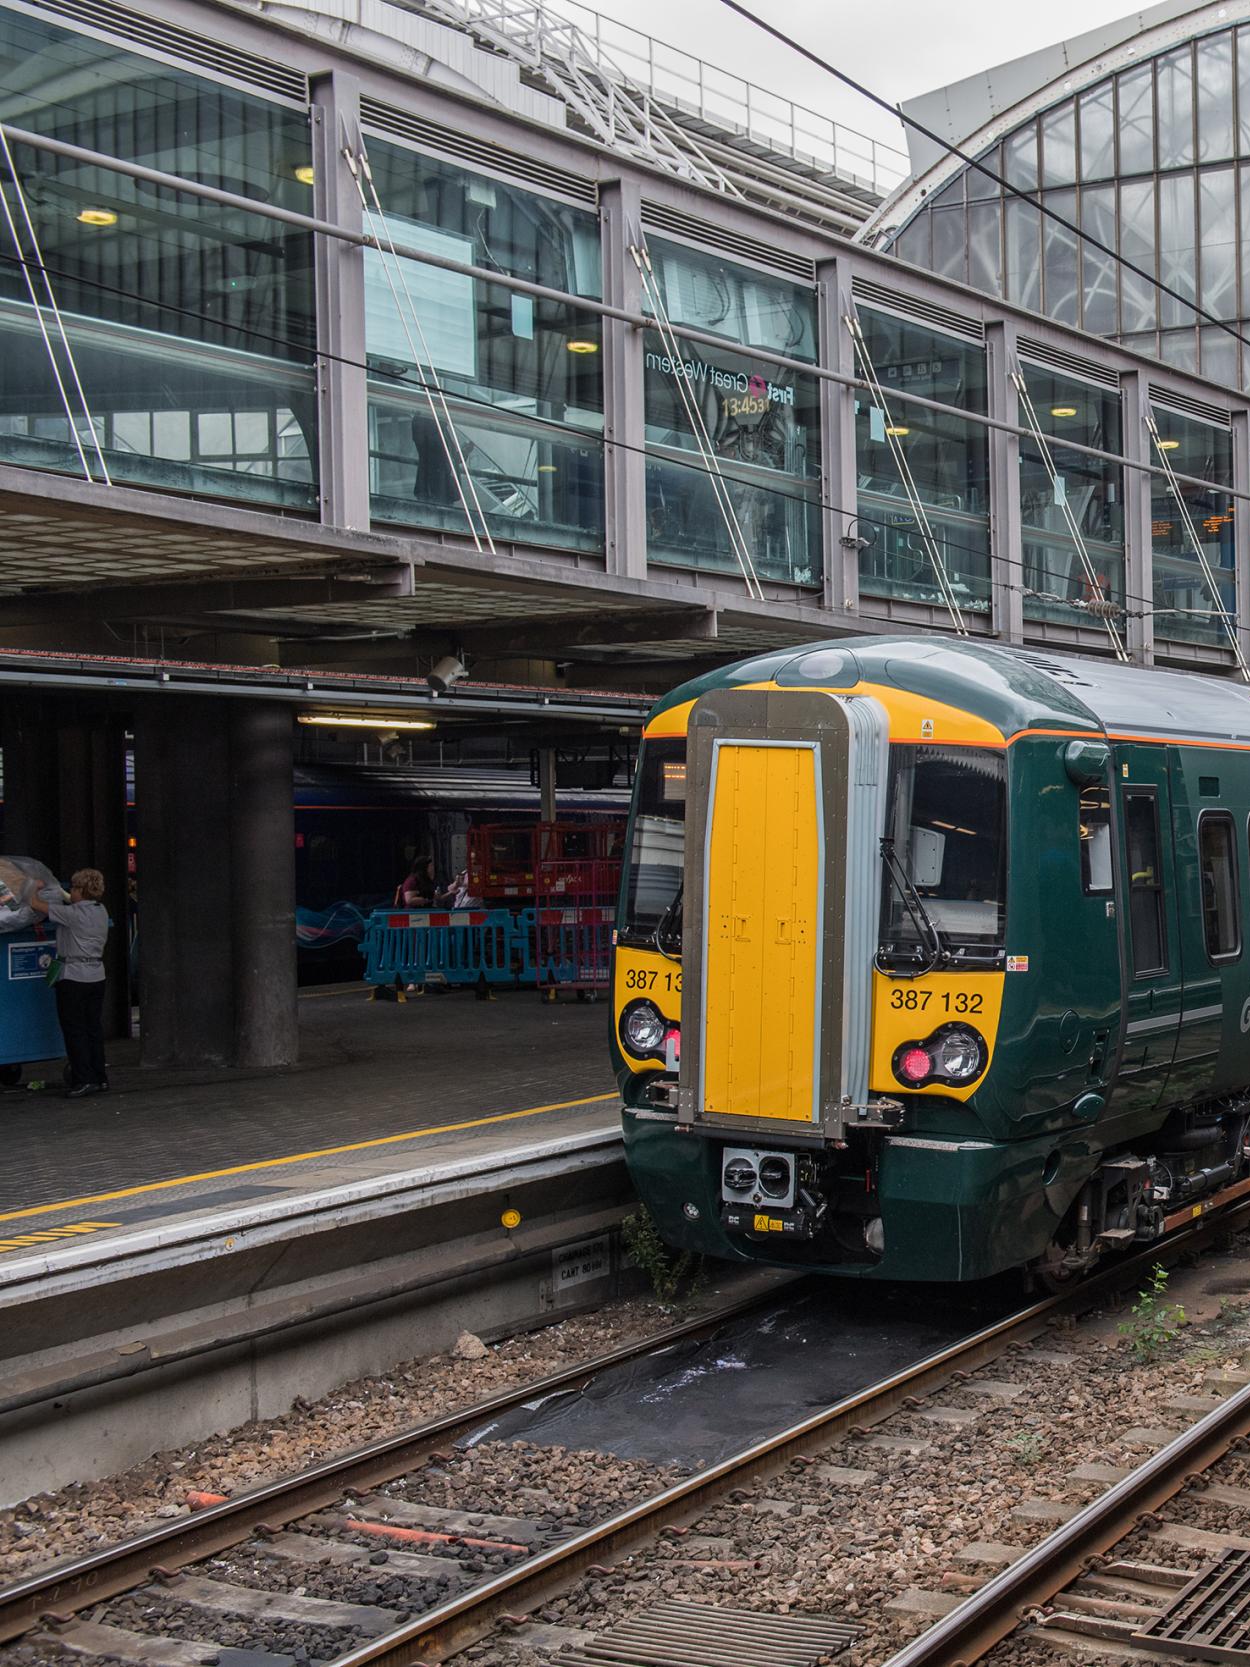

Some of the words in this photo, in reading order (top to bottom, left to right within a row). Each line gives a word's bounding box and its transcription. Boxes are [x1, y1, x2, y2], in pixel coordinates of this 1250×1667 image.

[626, 969, 658, 990] 387
[665, 973, 682, 993] 13
[890, 989, 933, 1011] 387
[941, 992, 984, 1014] 132
